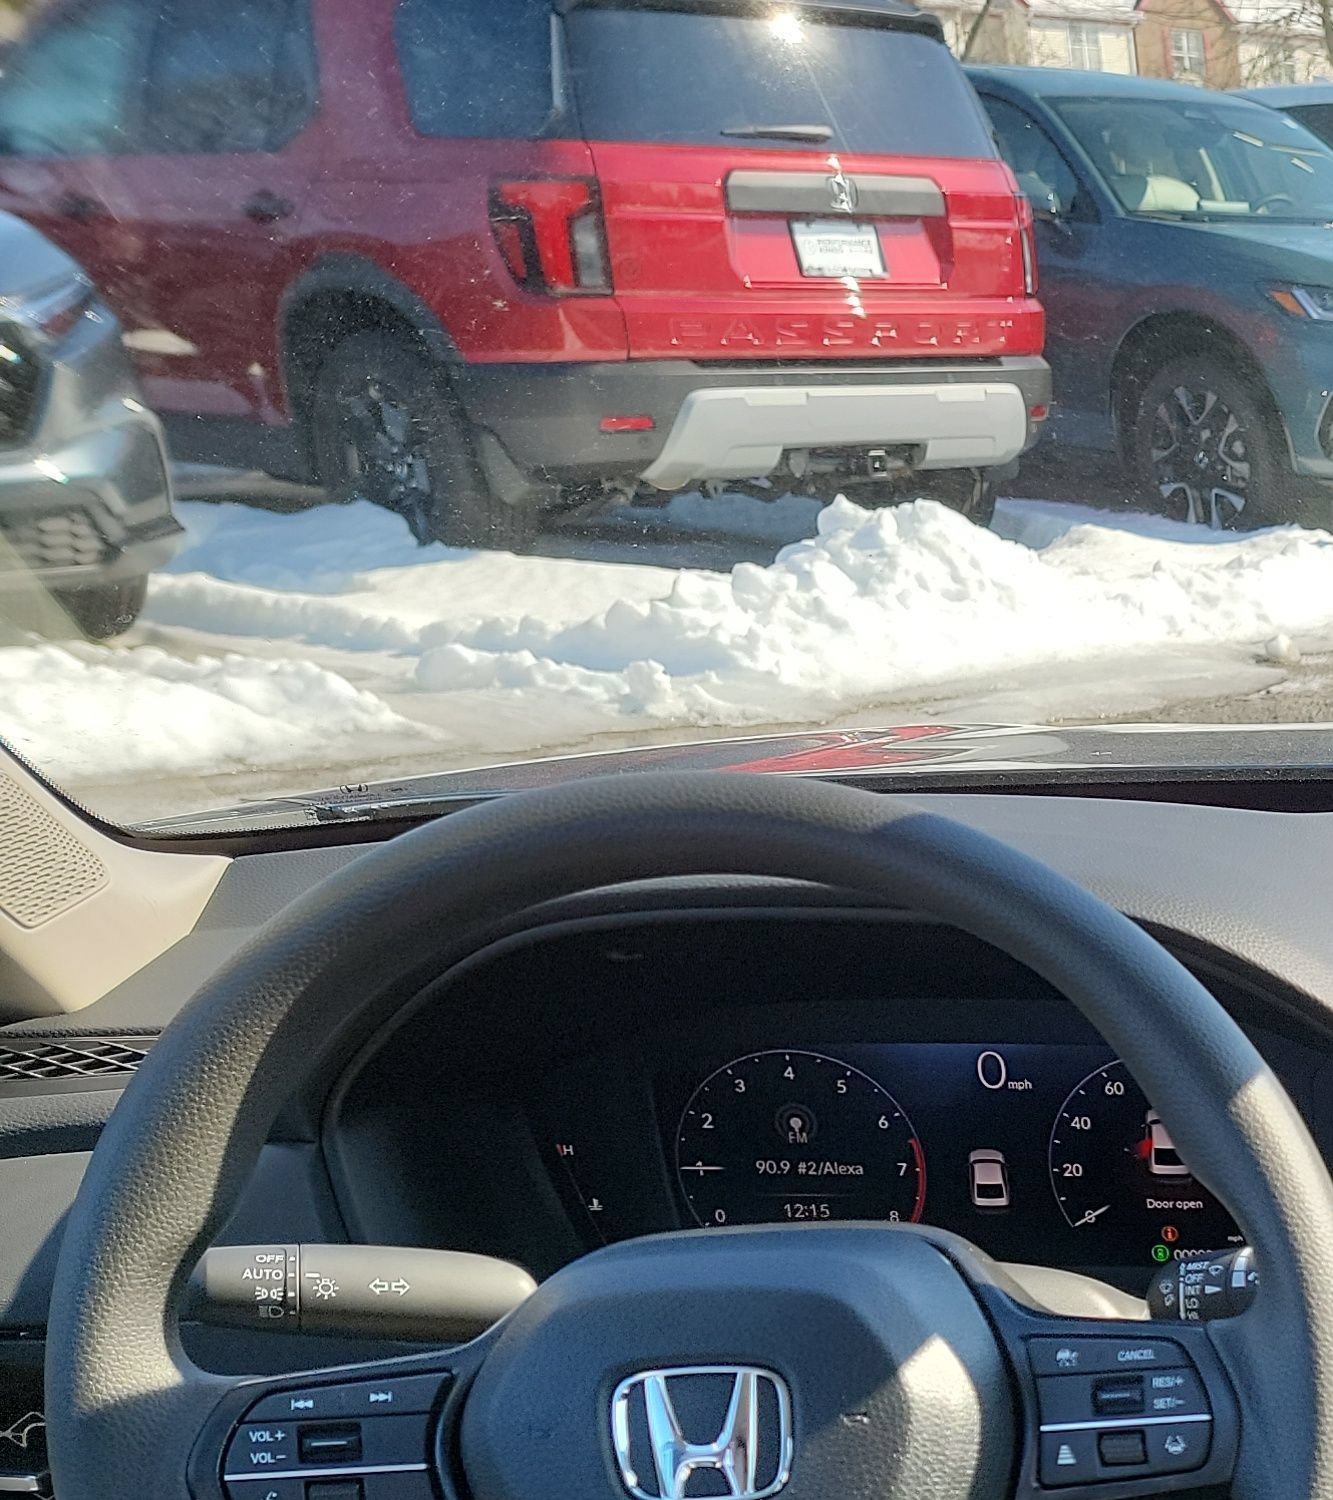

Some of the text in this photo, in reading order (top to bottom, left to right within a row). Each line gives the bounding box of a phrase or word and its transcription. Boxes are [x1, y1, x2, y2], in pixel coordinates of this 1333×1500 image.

[783, 1065, 796, 1081] 4
[977, 1051, 1033, 1091] 0 mph
[734, 1078, 747, 1094] 3
[836, 1079, 848, 1095] 5
[1105, 1081, 1125, 1096] 60
[702, 1113, 715, 1129] 2
[878, 1115, 889, 1130] 6
[1071, 1115, 1092, 1131] 40
[755, 1159, 864, 1176] 90.9 #2/Alexa
[897, 1163, 907, 1177] 7
[1063, 1163, 1083, 1178] 20
[784, 1204, 830, 1217] 12:15
[1146, 1199, 1203, 1210] Door open
[715, 1209, 726, 1223] 0
[256, 1254, 284, 1264] OFF
[1186, 1261, 1210, 1271] MIST
[242, 1269, 283, 1281] AUTO
[1185, 1274, 1204, 1284] OFF
[1185, 1285, 1200, 1296] INT
[1117, 1350, 1155, 1361] CANCEL
